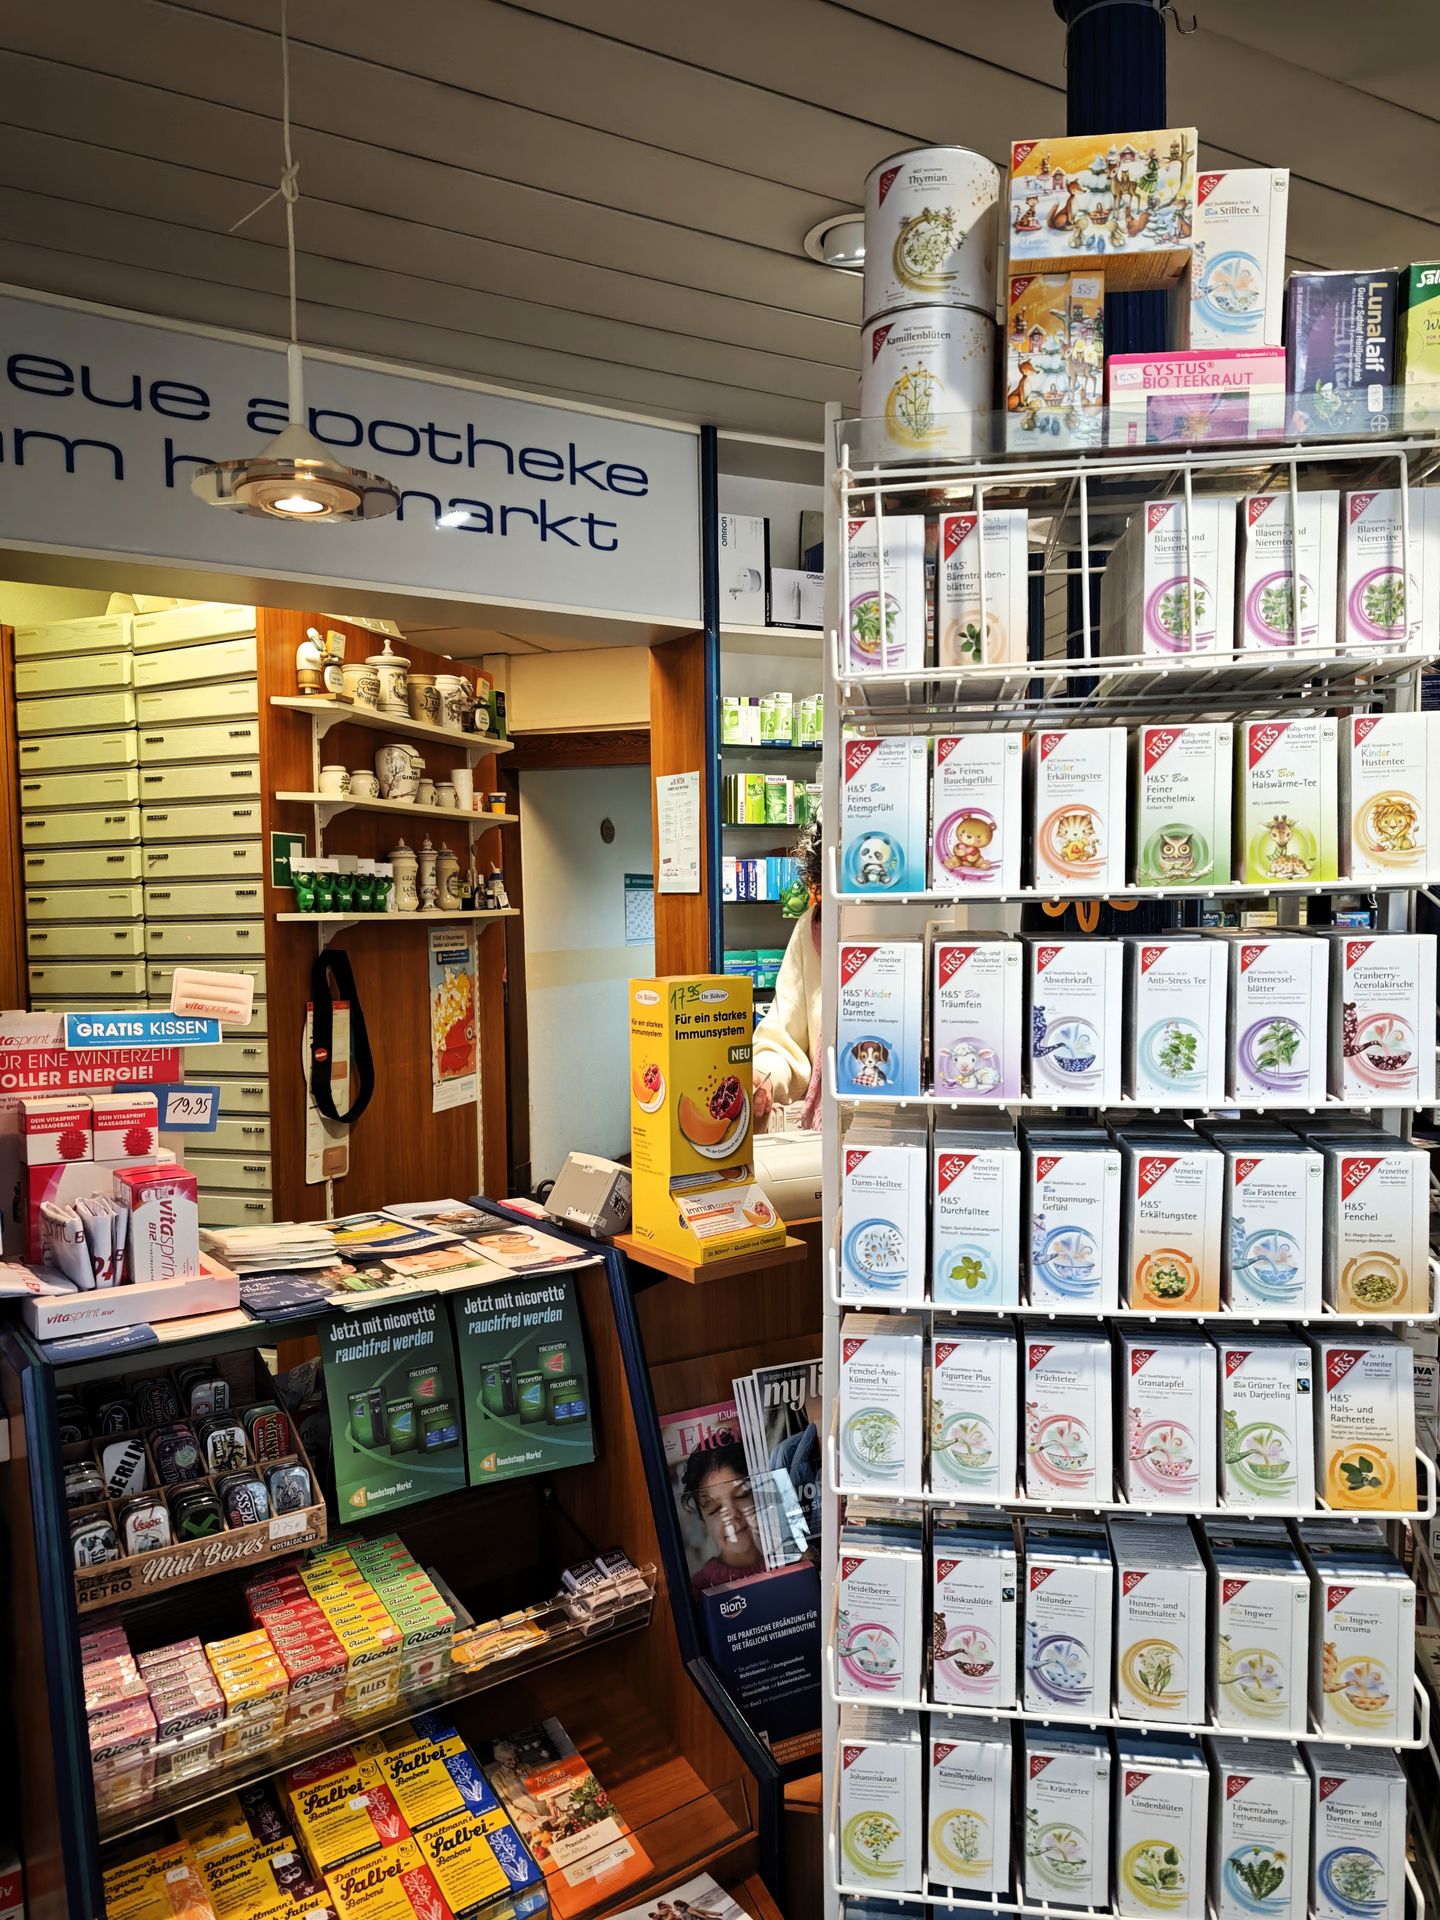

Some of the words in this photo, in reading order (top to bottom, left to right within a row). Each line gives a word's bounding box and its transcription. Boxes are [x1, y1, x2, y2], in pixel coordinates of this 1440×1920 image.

[908, 173, 948, 186] Thymian
[1200, 175, 1219, 196] H&S
[1219, 206, 1249, 215] Stilltee
[1252, 205, 1260, 214] N
[1357, 288, 1365, 308] Guter
[1357, 309, 1365, 334] Schlaf
[1365, 282, 1388, 372] Lunalaif
[886, 329, 951, 347] Kamillenblüten
[1354, 335, 1364, 382] Heißgetränk
[1143, 376, 1169, 388] BIO
[1174, 373, 1253, 387] TEEKRAUT
[246, 397, 648, 497] apotheke
[165, 437, 618, 552] hmarkt
[1352, 496, 1371, 514] H&S
[948, 519, 972, 545] H&S
[1255, 529, 1286, 537] Blasen-
[1357, 525, 1390, 533] Blasen-
[1155, 534, 1185, 542] Blasen-
[947, 583, 973, 591] blätter
[849, 744, 872, 769] H&S
[1361, 748, 1390, 758] Kinder
[1362, 758, 1405, 766] Hustentee
[960, 767, 984, 775] Feines
[1047, 764, 1073, 772] Kinder
[1277, 768, 1295, 778] Bio
[943, 776, 993, 785] Bauchgefühl
[1047, 772, 1102, 781] Erkältungstee
[1172, 774, 1189, 783] Bio
[870, 783, 886, 793] Bio
[1146, 785, 1173, 793] Feiner
[1252, 778, 1317, 789] Halswärme-Tee
[1146, 794, 1195, 803] Fenchelmix
[847, 803, 893, 813] Atemgefühl
[873, 956, 901, 964] Arzneitee
[1043, 976, 1093, 984] Abwehrkraft
[1148, 976, 1192, 985] Anti-Stress
[1194, 976, 1207, 984] Tee
[1248, 976, 1296, 984] Brennessel-
[1353, 972, 1400, 981] Cranberry-
[1247, 984, 1275, 993] blätter
[1353, 980, 1414, 990] Acerolakirsche
[864, 989, 892, 998] Kinder
[965, 990, 980, 998] Bio
[843, 999, 874, 1008] Magen-
[941, 1000, 982, 1009] Träumfein
[675, 1014, 691, 1024] Für
[695, 1012, 710, 1023] ein
[714, 1011, 747, 1021] starkes
[843, 1008, 876, 1016] Darmtee
[77, 1022, 144, 1037] GRATIS
[150, 1021, 207, 1035] KISSEN
[675, 1026, 744, 1040] Immunsystem
[29, 1054, 69, 1068] EINE
[73, 1048, 174, 1065] WINTERZEIT
[731, 1048, 750, 1060] NEU
[0, 1072, 61, 1088] OLLER
[69, 1066, 153, 1083] ENERGIE!
[168, 1097, 213, 1115] 19,95
[942, 1158, 966, 1181] H&S
[851, 1179, 903, 1189] Darm-Heiltee
[1242, 1188, 1255, 1196] Bio
[1257, 1189, 1297, 1197] Fastentee
[1043, 1195, 1100, 1205] Entspannungs-
[687, 1204, 715, 1215] Immun
[940, 1206, 989, 1216] Durchfalltee
[1042, 1203, 1068, 1212] Gefühl
[1140, 1210, 1197, 1221] Erkältungstee
[1345, 1212, 1378, 1221] Fenchel
[149, 1222, 157, 1240] B12
[464, 1296, 493, 1314] Jetzt
[495, 1293, 514, 1309] mit
[47, 1308, 100, 1325] vitasprint
[468, 1313, 521, 1335] rauchfrei
[523, 1307, 562, 1326] werden
[330, 1320, 361, 1341] Jetzt
[362, 1316, 382, 1335] mit
[336, 1336, 390, 1363] rauchfrei
[393, 1329, 433, 1351] werden
[409, 1366, 438, 1377] nicorette
[1332, 1354, 1355, 1379] H&S
[849, 1368, 901, 1377] Fenchel-Anis-
[941, 1372, 973, 1381] Figurtee
[849, 1376, 879, 1385] Kümmel
[1035, 1374, 1077, 1383] Früchtetee
[1138, 1379, 1184, 1389] Granatapfel
[1248, 1381, 1274, 1390] Grüner
[1277, 1382, 1291, 1390] Tee
[763, 1377, 806, 1411] my
[1249, 1390, 1290, 1400] Darjeeling
[388, 1402, 413, 1413] nicorette
[421, 1404, 449, 1415] nicorette
[1330, 1404, 1353, 1413] Hals-
[1357, 1406, 1373, 1414] und
[1330, 1414, 1376, 1424] Rachentee
[107, 1439, 145, 1499] BERLIN
[133, 1516, 161, 1532] Vespa
[142, 1554, 200, 1584] Mint
[203, 1535, 267, 1567] Boxes
[79, 1581, 132, 1604] RETRO
[848, 1584, 891, 1595] Heidelbeere
[943, 1595, 993, 1605] Hibiskusblüte
[1036, 1595, 1072, 1605] Holunder
[1130, 1599, 1161, 1608] Husten-
[1163, 1602, 1178, 1610] und
[720, 1598, 746, 1614] Bion3
[1129, 1608, 1177, 1618] Bronchialtee
[1244, 1609, 1273, 1618] Ingwer
[738, 1624, 771, 1640] PRAKTISCHE
[772, 1614, 806, 1629] ERGÄNZUNG
[806, 1610, 817, 1619] FÜR
[1350, 1616, 1383, 1626] Ingwer-
[1334, 1624, 1371, 1633] Curcuma
[407, 1626, 451, 1646] Ricola
[732, 1644, 742, 1652] DIE
[742, 1635, 768, 1649] TÄGLICHE
[769, 1621, 816, 1641] VITAMINROUTINE
[352, 1645, 398, 1667] Ricola
[294, 1665, 345, 1689] Ricola
[164, 1708, 220, 1736] Ricola
[384, 1741, 433, 1765] Dallmann's
[390, 1746, 452, 1779] Salbei-
[849, 1773, 897, 1783] Johanniskraut
[939, 1770, 993, 1783] Kamillenblüten
[1050, 1785, 1090, 1795] Kräutertee
[1131, 1800, 1184, 1813] Lindenblüten
[1233, 1804, 1278, 1815] Löwenzahn
[1326, 1806, 1358, 1816] Magen-
[1362, 1810, 1377, 1818] und
[1232, 1813, 1290, 1825] Fettverdauungs-
[1326, 1815, 1361, 1825] Darmtee
[1364, 1818, 1382, 1827] mild
[423, 1816, 473, 1843] Dallmann's
[431, 1820, 495, 1858] Salbei-
